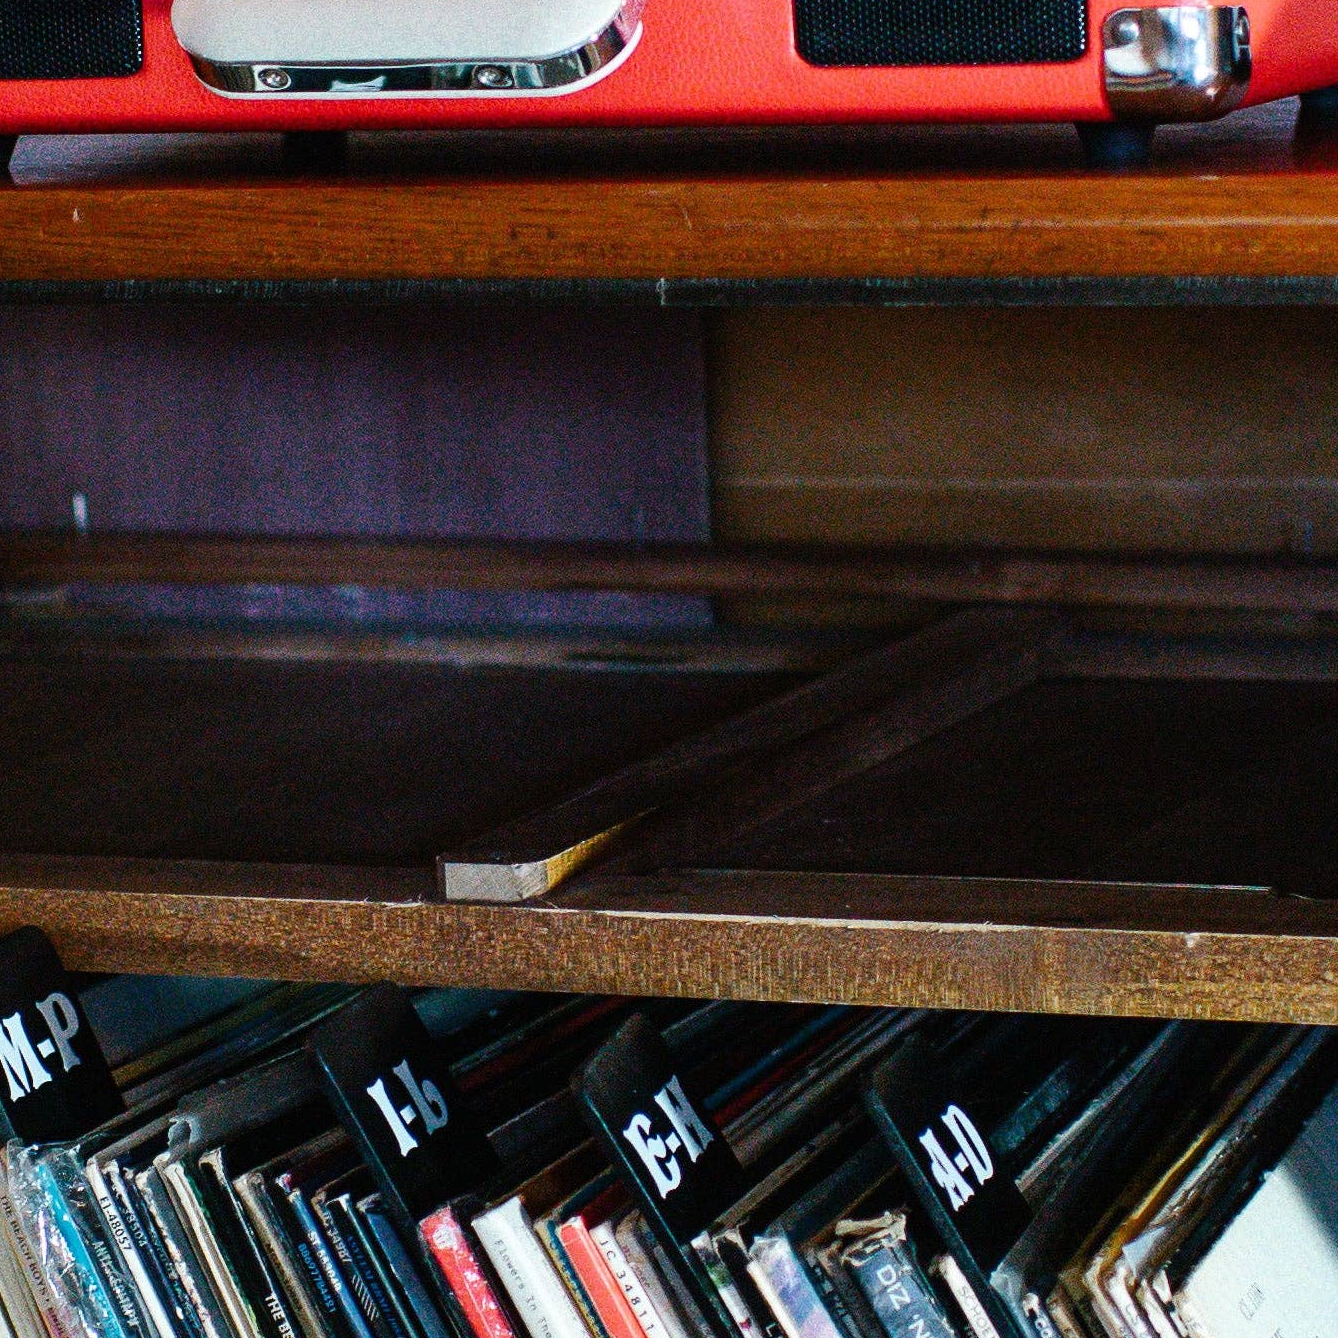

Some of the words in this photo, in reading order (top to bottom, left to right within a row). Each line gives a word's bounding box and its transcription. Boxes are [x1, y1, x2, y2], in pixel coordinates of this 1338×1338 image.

[622, 1074, 715, 1201] E-H
[917, 1102, 995, 1212] A-D
[9, 1219, 34, 1261] BEACH
[99, 1195, 132, 1252] E1-48057
[493, 1237, 528, 1290] Flowers
[525, 1294, 540, 1312] In
[615, 1268, 655, 1331] 34811
[875, 1263, 912, 1309] DIZ
[263, 1292, 285, 1321] THE
